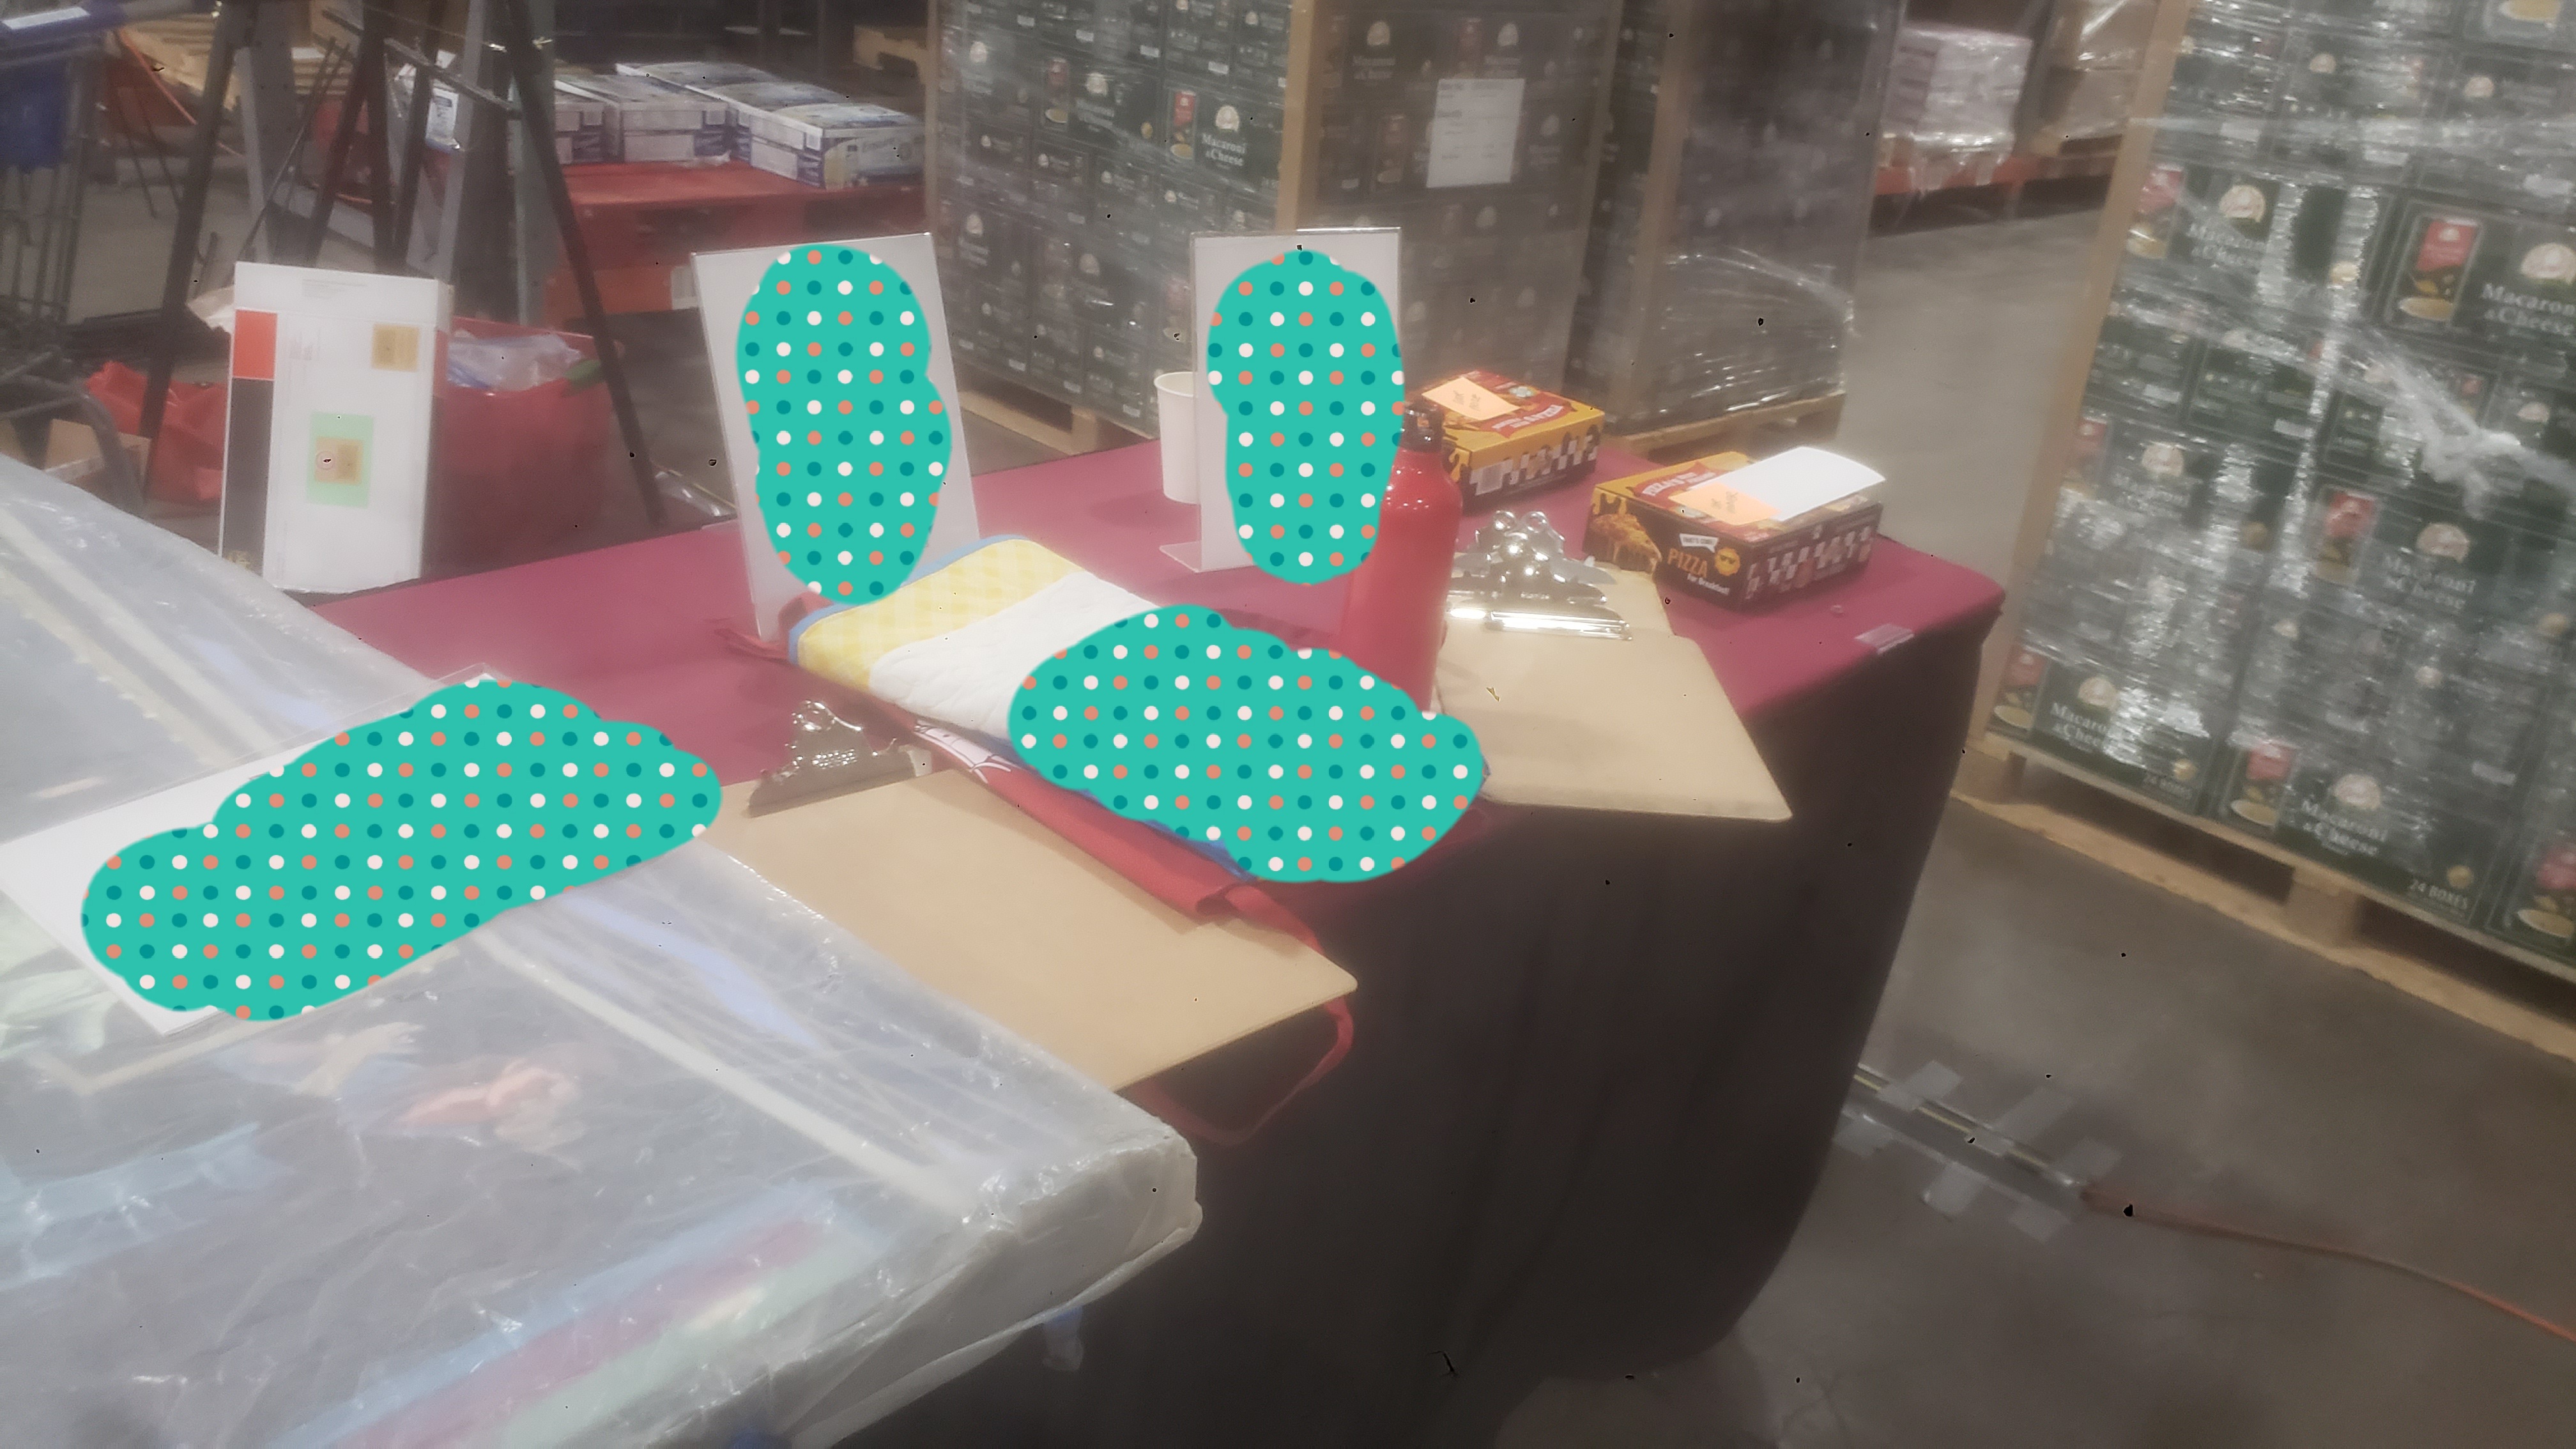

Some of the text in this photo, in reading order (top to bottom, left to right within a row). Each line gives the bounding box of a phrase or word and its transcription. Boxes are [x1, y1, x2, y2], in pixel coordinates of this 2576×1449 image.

[1202, 133, 1246, 154] Macaroni
[2481, 282, 2575, 316] Macaron
[1667, 548, 1708, 578] PIZZA
[2050, 702, 2108, 733] Macaro
[2301, 800, 2389, 842] Macaroni
